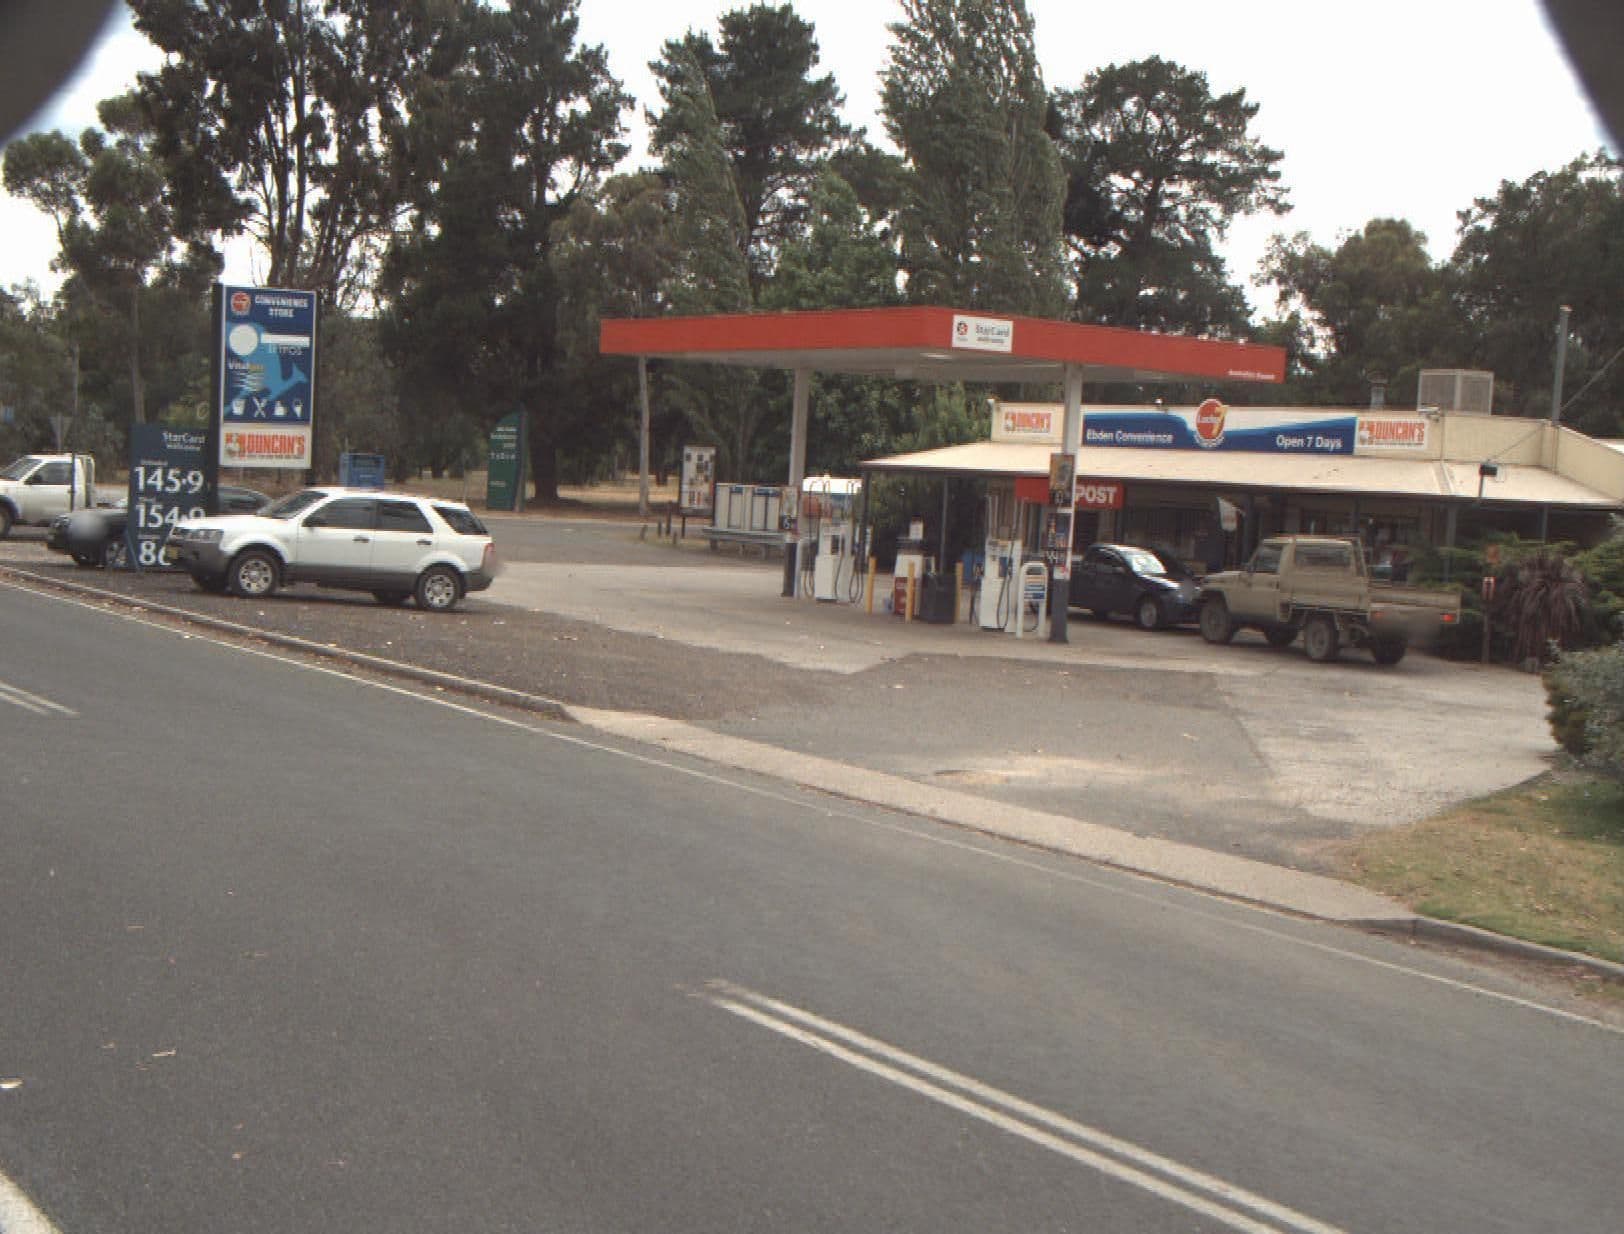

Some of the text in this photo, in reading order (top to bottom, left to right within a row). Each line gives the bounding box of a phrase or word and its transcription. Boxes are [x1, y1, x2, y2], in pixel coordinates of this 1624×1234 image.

[1086, 429, 1174, 445] Ebden Convenience
[1275, 434, 1342, 451] Open 7 Days
[1075, 485, 1118, 504] POST
